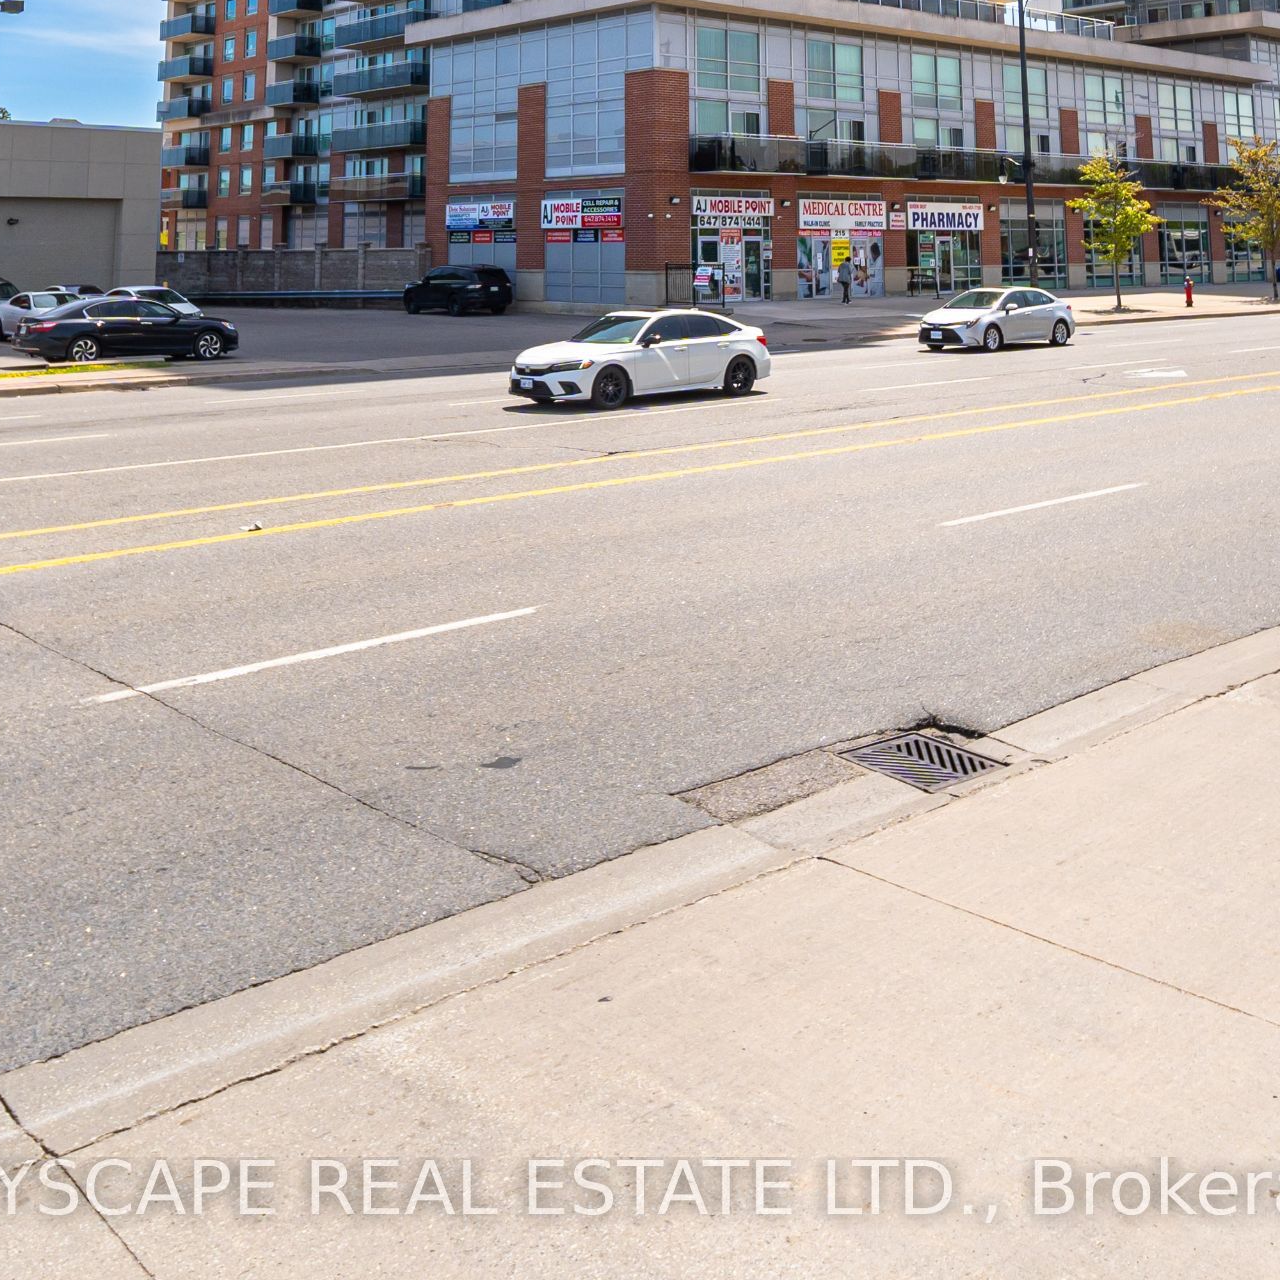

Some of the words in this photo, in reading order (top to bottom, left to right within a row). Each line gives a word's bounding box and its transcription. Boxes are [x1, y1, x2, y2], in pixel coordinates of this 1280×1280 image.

[492, 209, 509, 217] POINT
[543, 203, 553, 224] AJ
[553, 202, 581, 213] MOBILE
[695, 199, 707, 212] AJ
[709, 199, 742, 213] MOBILE
[745, 200, 771, 213] POINT
[803, 201, 846, 216] MEDICAL
[848, 202, 884, 216] CENTRE
[555, 215, 578, 225] POINT
[699, 216, 717, 226] 647
[721, 216, 739, 226] 874
[742, 216, 761, 226] 1414
[912, 211, 979, 228] PHARMACY
